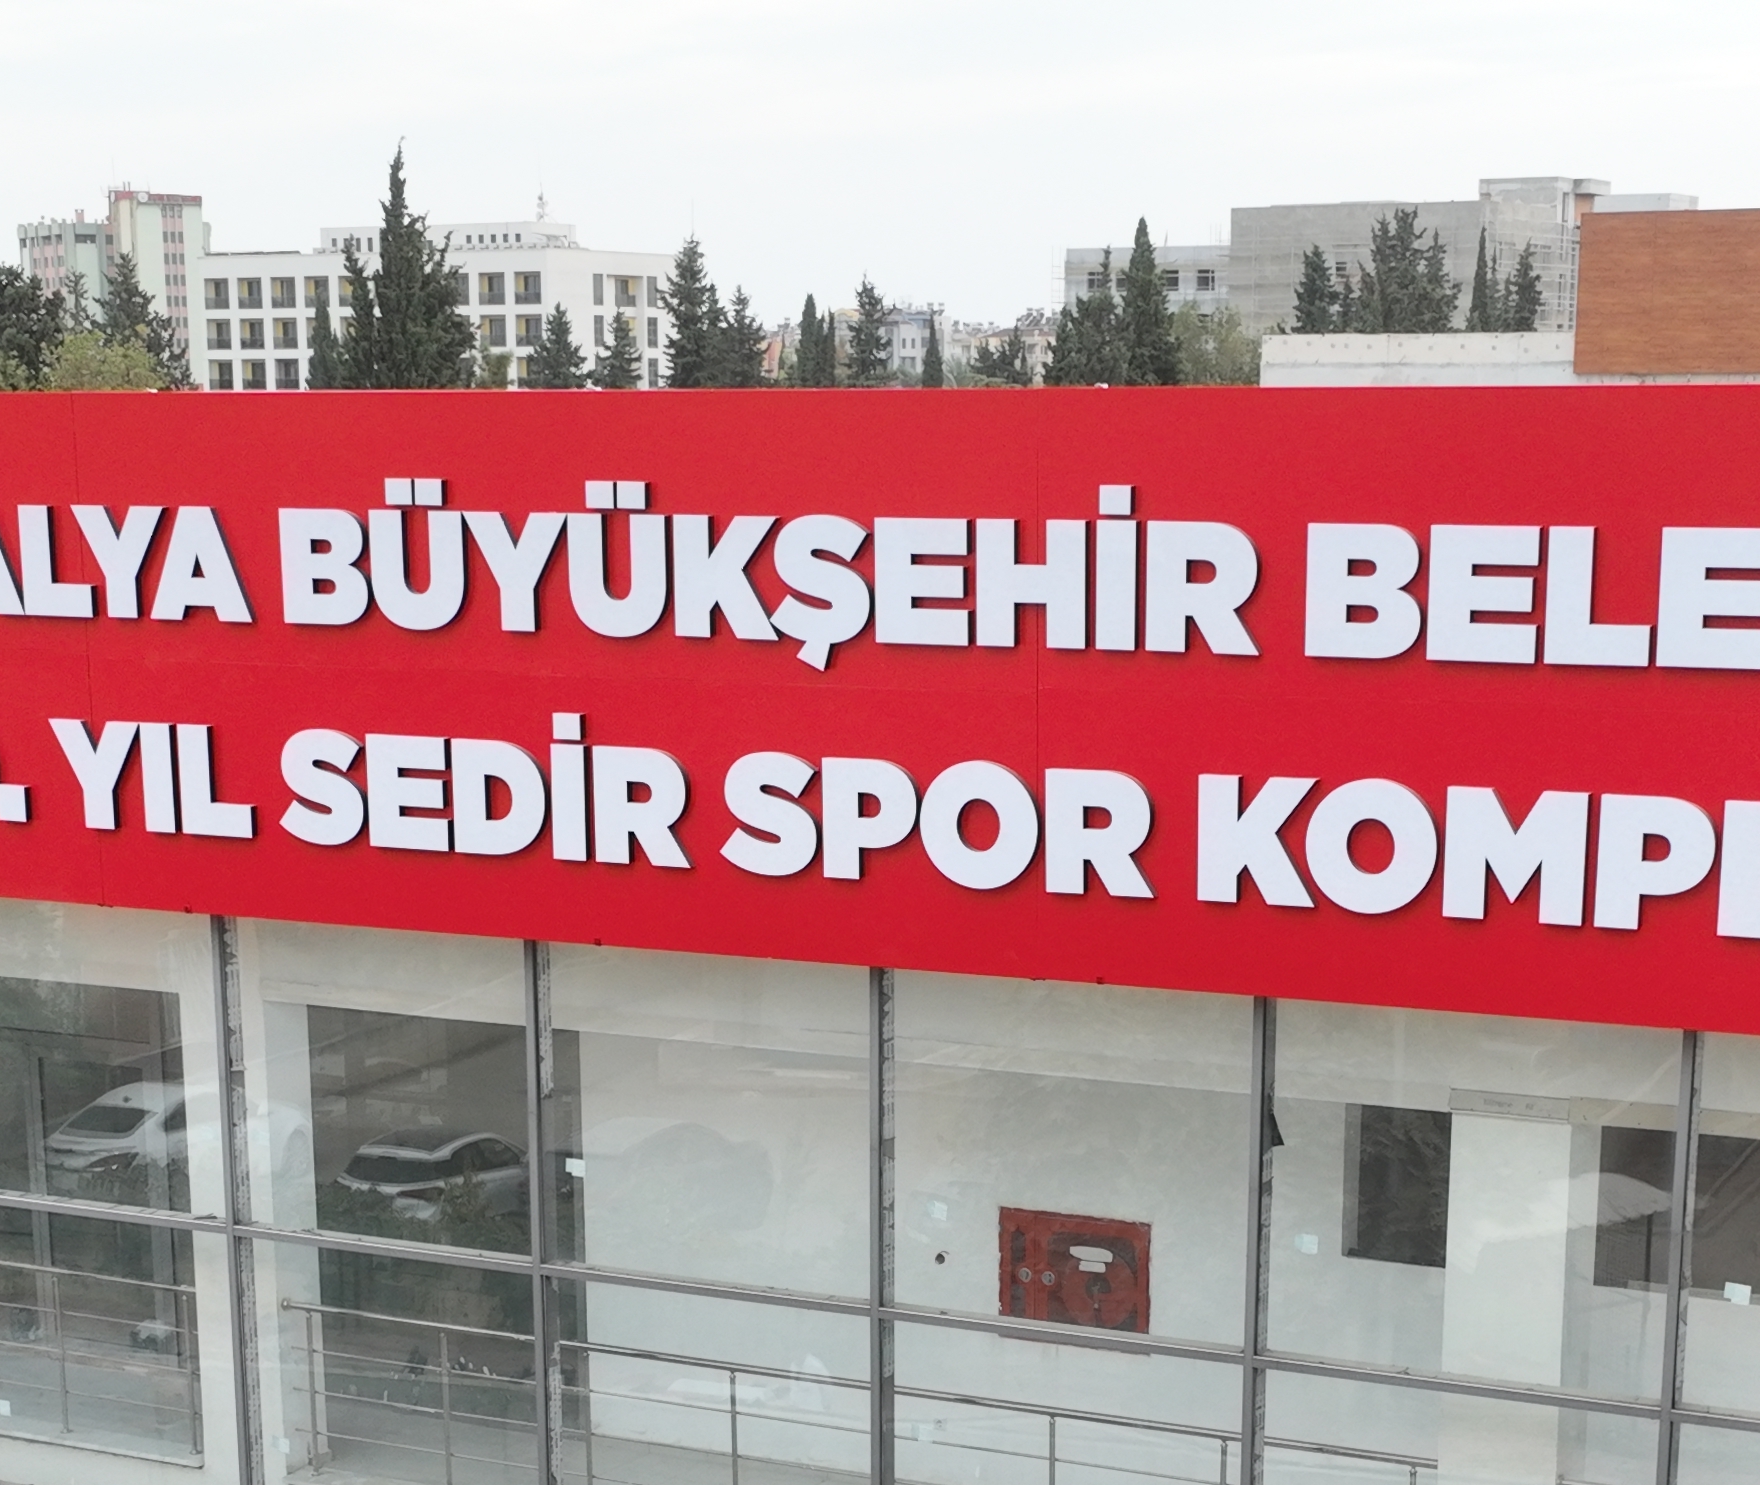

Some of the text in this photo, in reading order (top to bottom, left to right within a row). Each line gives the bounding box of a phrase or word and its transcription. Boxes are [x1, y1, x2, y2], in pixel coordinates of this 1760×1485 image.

[279, 477, 1259, 672] BÜYÜKŞEHİR
[49, 718, 253, 840] YIL
[280, 712, 691, 870] SEDİR
[720, 751, 1154, 899] SPOR
